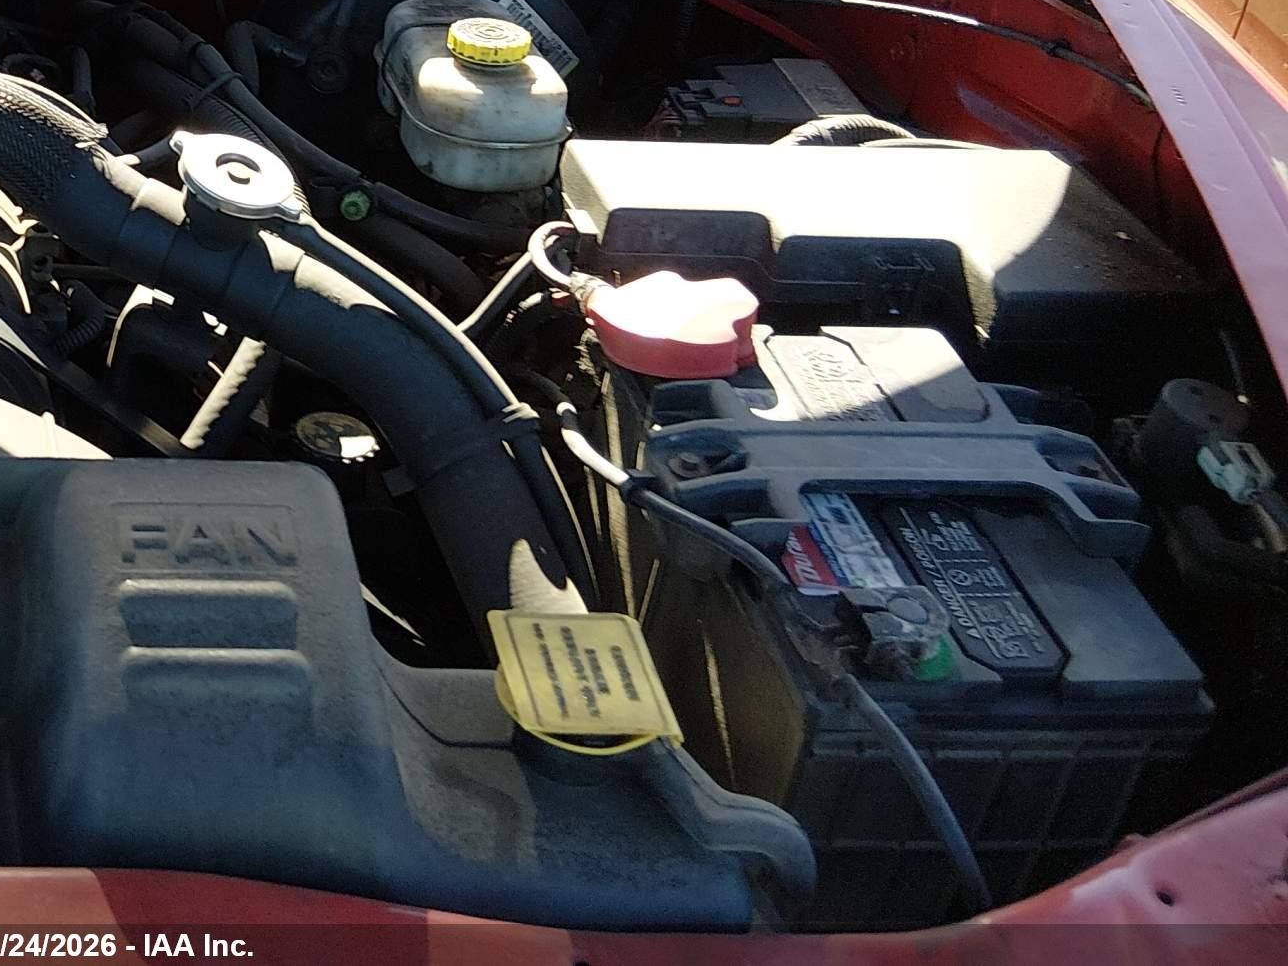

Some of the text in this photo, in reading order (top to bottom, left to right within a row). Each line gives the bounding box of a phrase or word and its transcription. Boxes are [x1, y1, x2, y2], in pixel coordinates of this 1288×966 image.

[118, 517, 298, 567] FAN
[898, 527, 936, 569] POISON
[932, 579, 974, 627] DANGER
